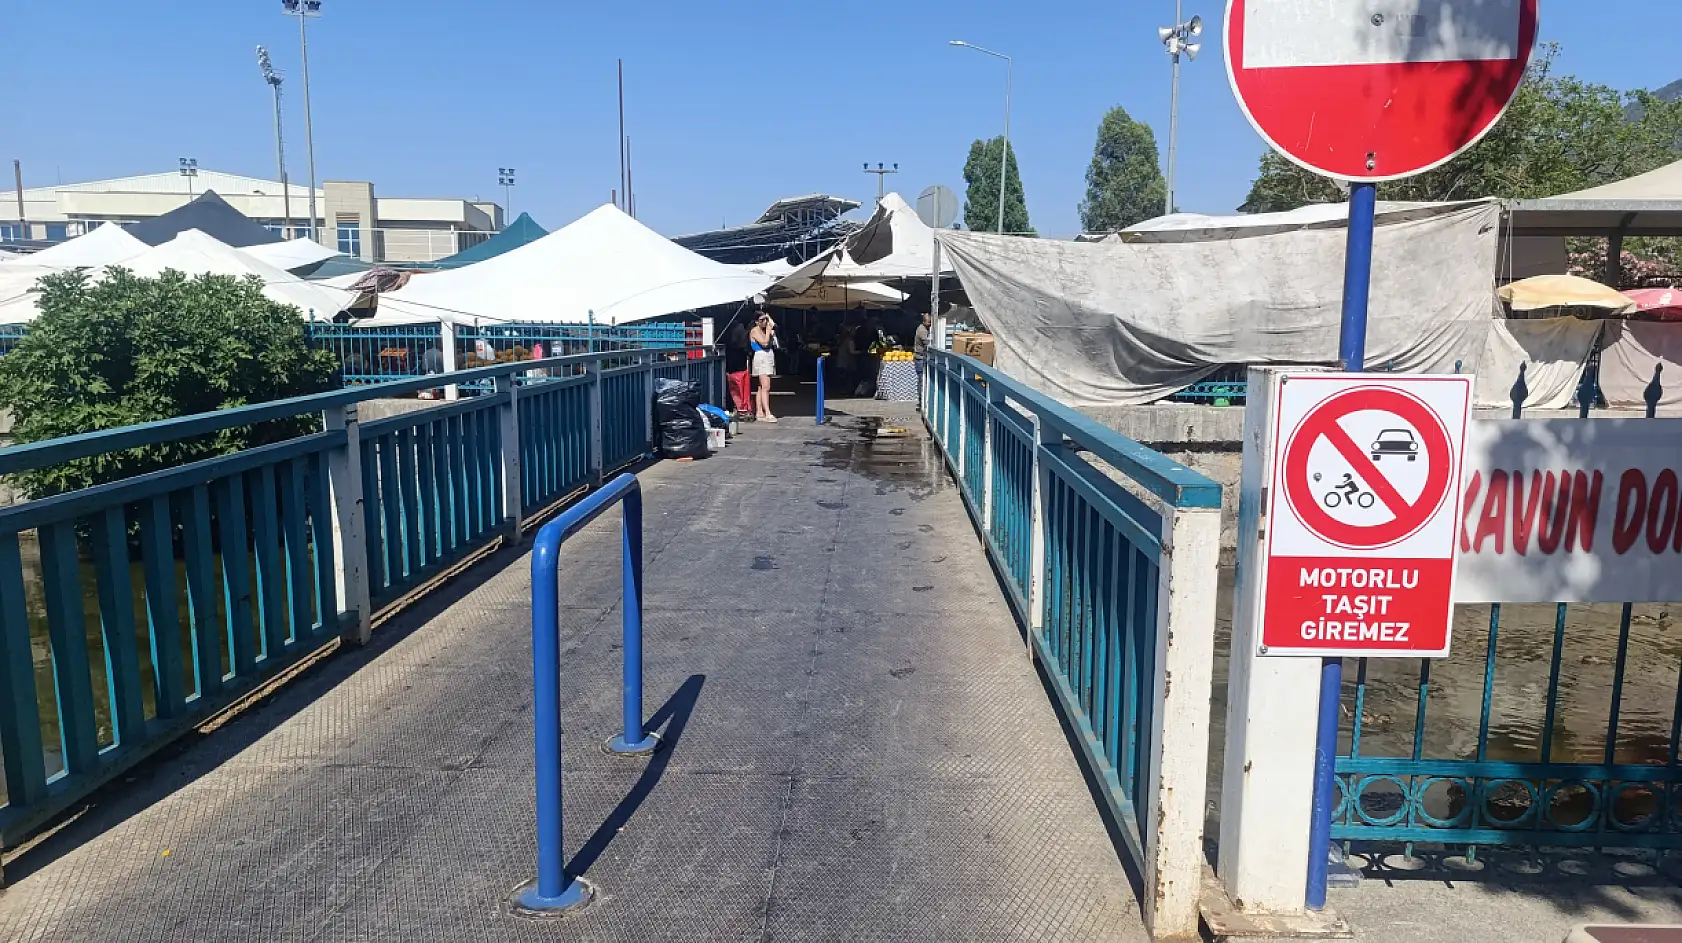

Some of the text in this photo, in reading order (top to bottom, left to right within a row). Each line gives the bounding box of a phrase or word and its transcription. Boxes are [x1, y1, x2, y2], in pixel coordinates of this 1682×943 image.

[1612, 468, 1682, 555] DO
[1299, 567, 1419, 588] MOTORLU
[1322, 594, 1392, 620] TAŞIT
[1300, 616, 1410, 642] GİREMEZ
